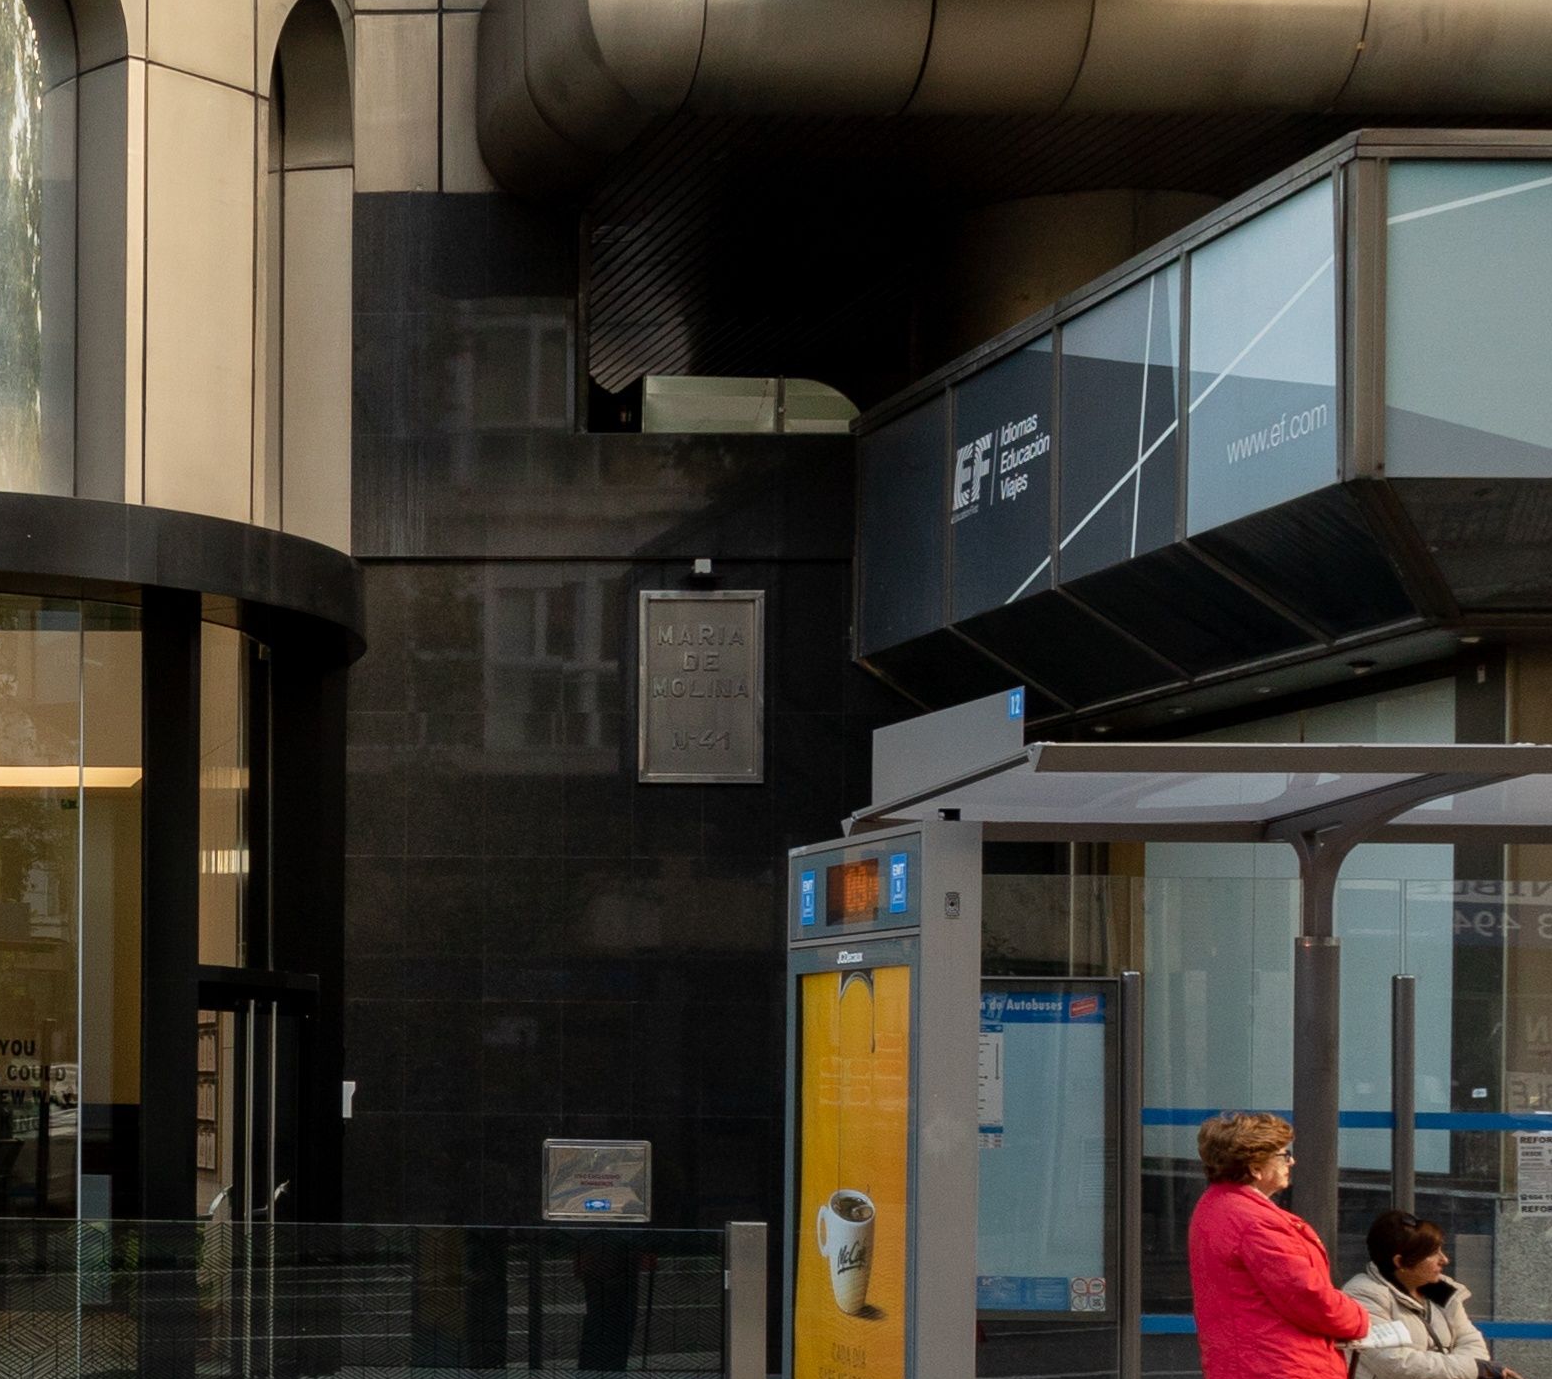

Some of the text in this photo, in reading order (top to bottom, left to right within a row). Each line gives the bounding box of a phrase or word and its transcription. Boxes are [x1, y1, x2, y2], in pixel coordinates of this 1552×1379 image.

[1000, 414, 1038, 447] Idiomas
[1227, 404, 1327, 464] www.ef.com
[1000, 432, 1051, 474] Educación
[952, 432, 993, 511] EF
[1000, 473, 1029, 501] Viajes
[657, 625, 745, 646] MARIA
[682, 652, 720, 672] DE
[652, 677, 749, 699] MOLINA
[1006, 998, 1063, 1011] Autobuses
[0, 1039, 36, 1056] YOU
